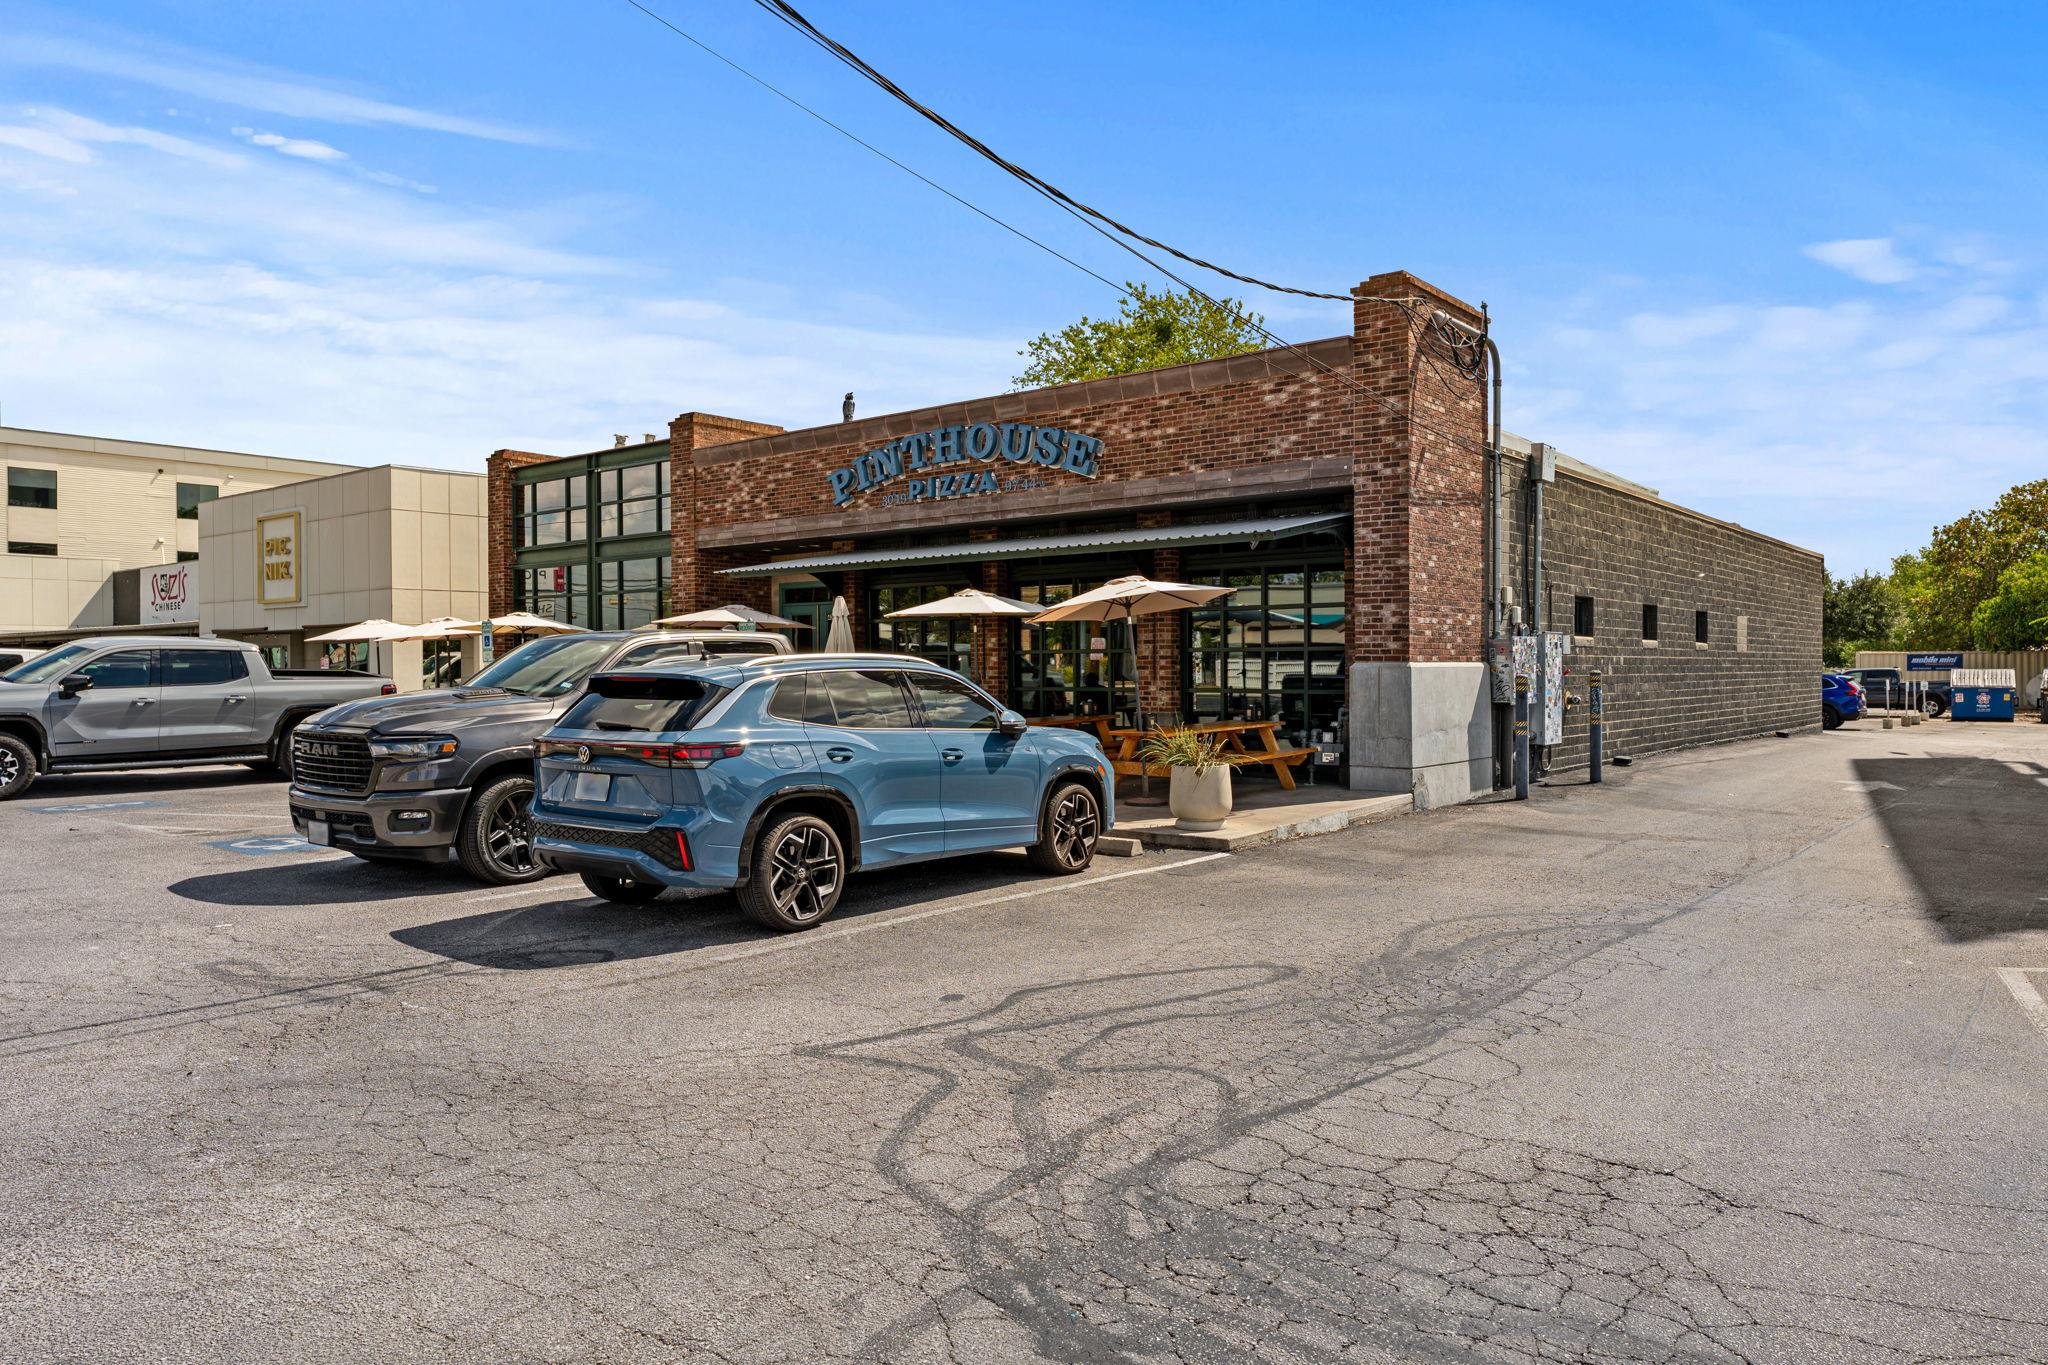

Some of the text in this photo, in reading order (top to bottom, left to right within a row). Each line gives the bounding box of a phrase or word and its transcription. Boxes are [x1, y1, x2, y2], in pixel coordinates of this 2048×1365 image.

[826, 422, 1104, 507] PINTHOUSE
[908, 469, 1000, 501] PIZZA
[265, 537, 292, 556] PIC
[151, 565, 187, 606] SUZI'S
[155, 602, 181, 611] CHINESE
[300, 741, 339, 756] RAM
